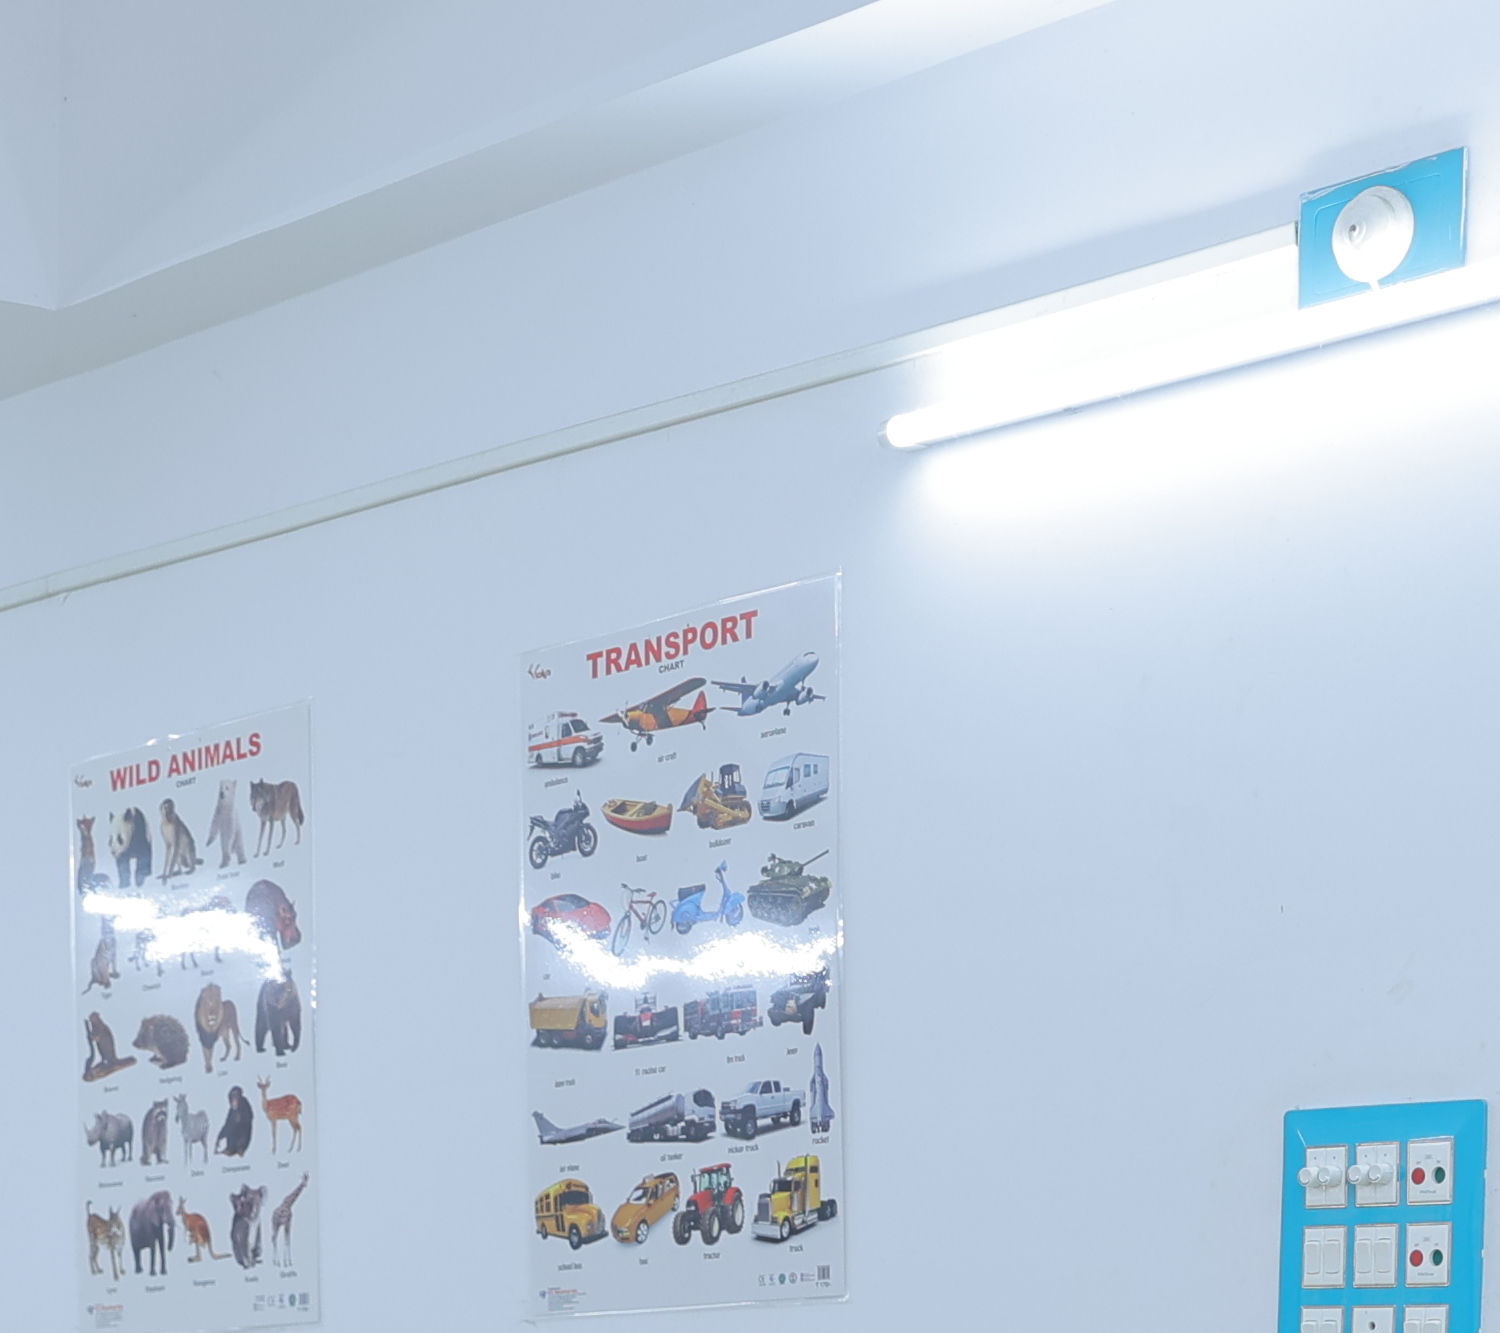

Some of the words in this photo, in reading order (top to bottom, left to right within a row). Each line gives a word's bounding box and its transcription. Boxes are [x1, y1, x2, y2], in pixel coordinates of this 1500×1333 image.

[586, 609, 759, 679] TRANSPORT
[658, 659, 685, 674] CHART
[109, 759, 161, 792] WILD
[167, 732, 263, 778] ANIMALS
[176, 777, 196, 789] CHART
[793, 819, 815, 831] caravan
[812, 1136, 830, 1145] rocket
[789, 1244, 804, 1253] truck
